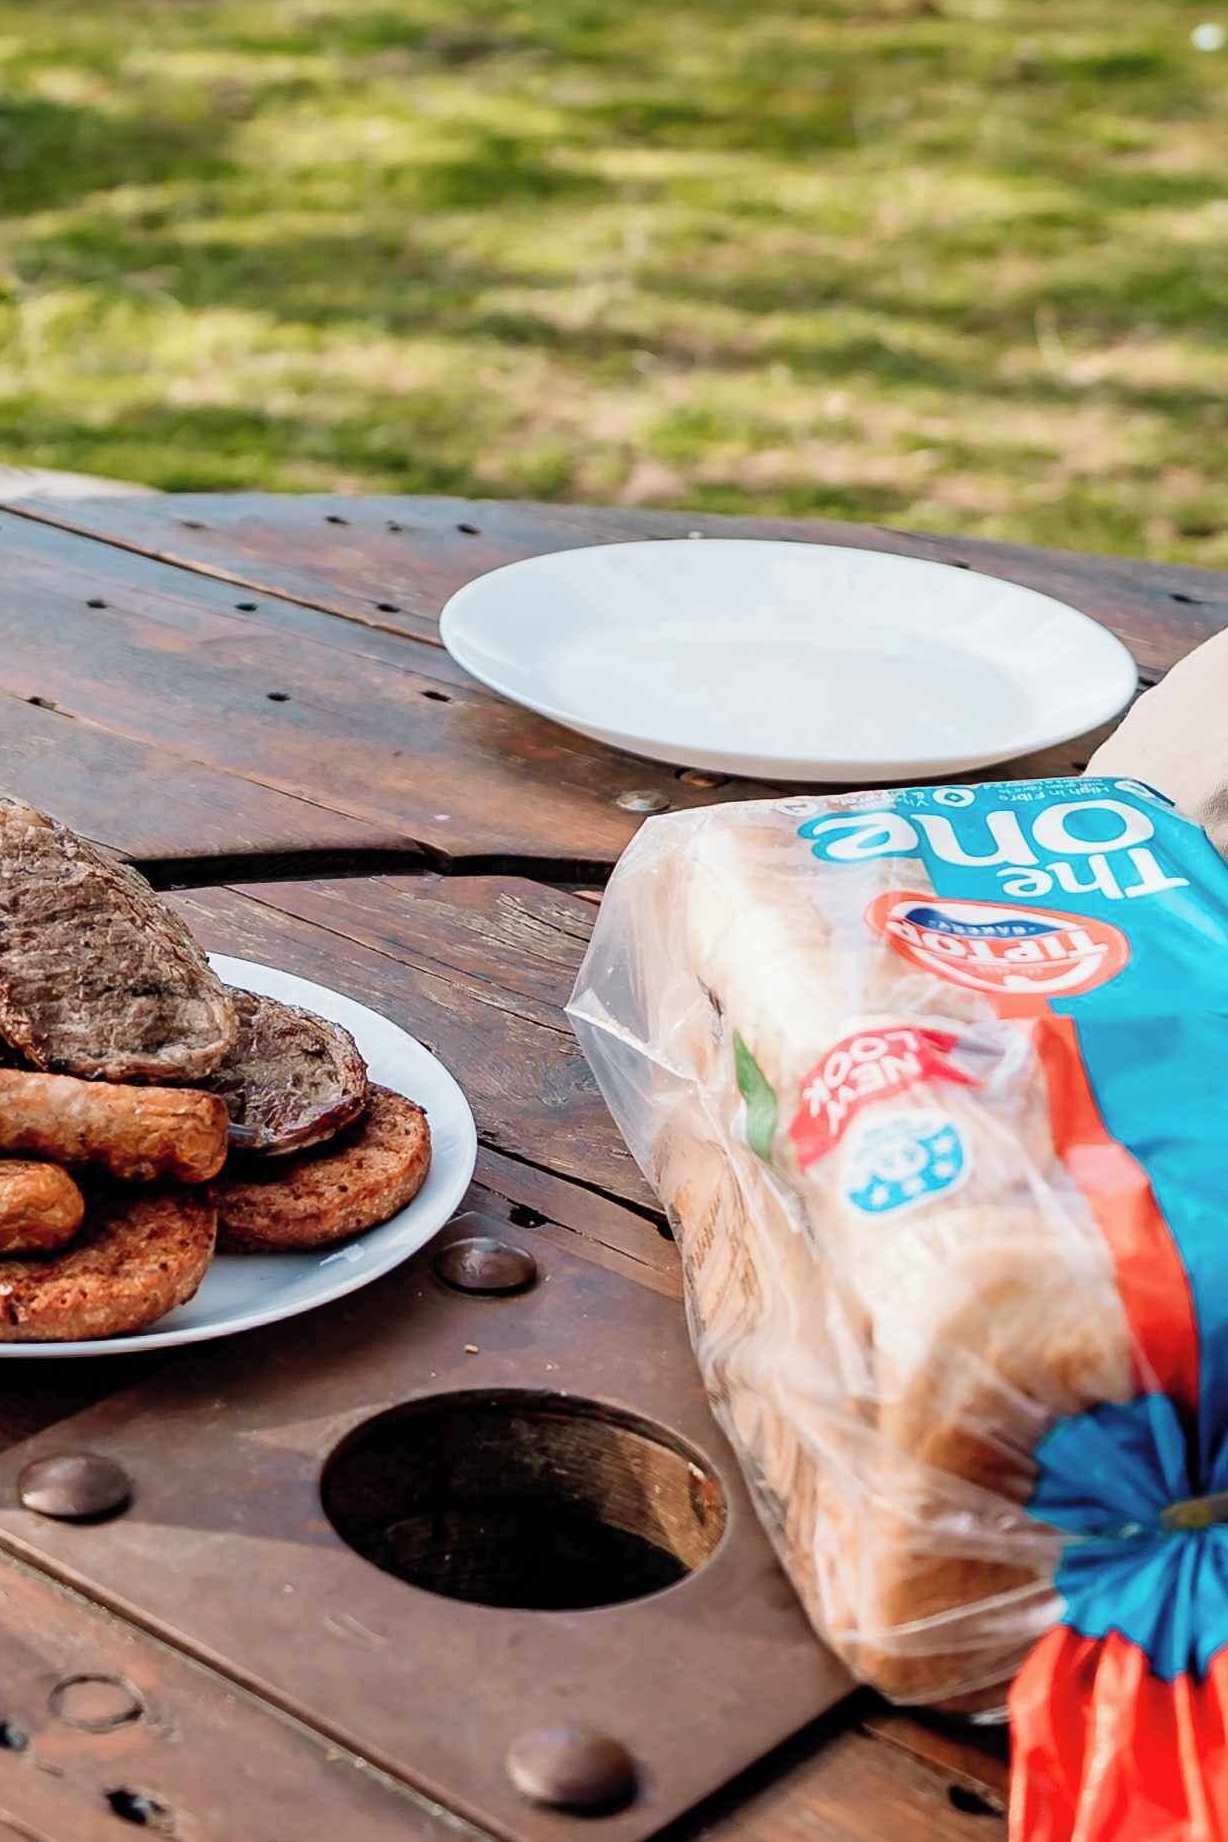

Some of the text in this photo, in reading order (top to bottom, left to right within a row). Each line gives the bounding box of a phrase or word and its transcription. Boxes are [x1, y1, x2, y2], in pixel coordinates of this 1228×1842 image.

[996, 847, 1190, 900] The
[802, 1030, 919, 1118] LOOK
[825, 1051, 922, 1135] NEW
